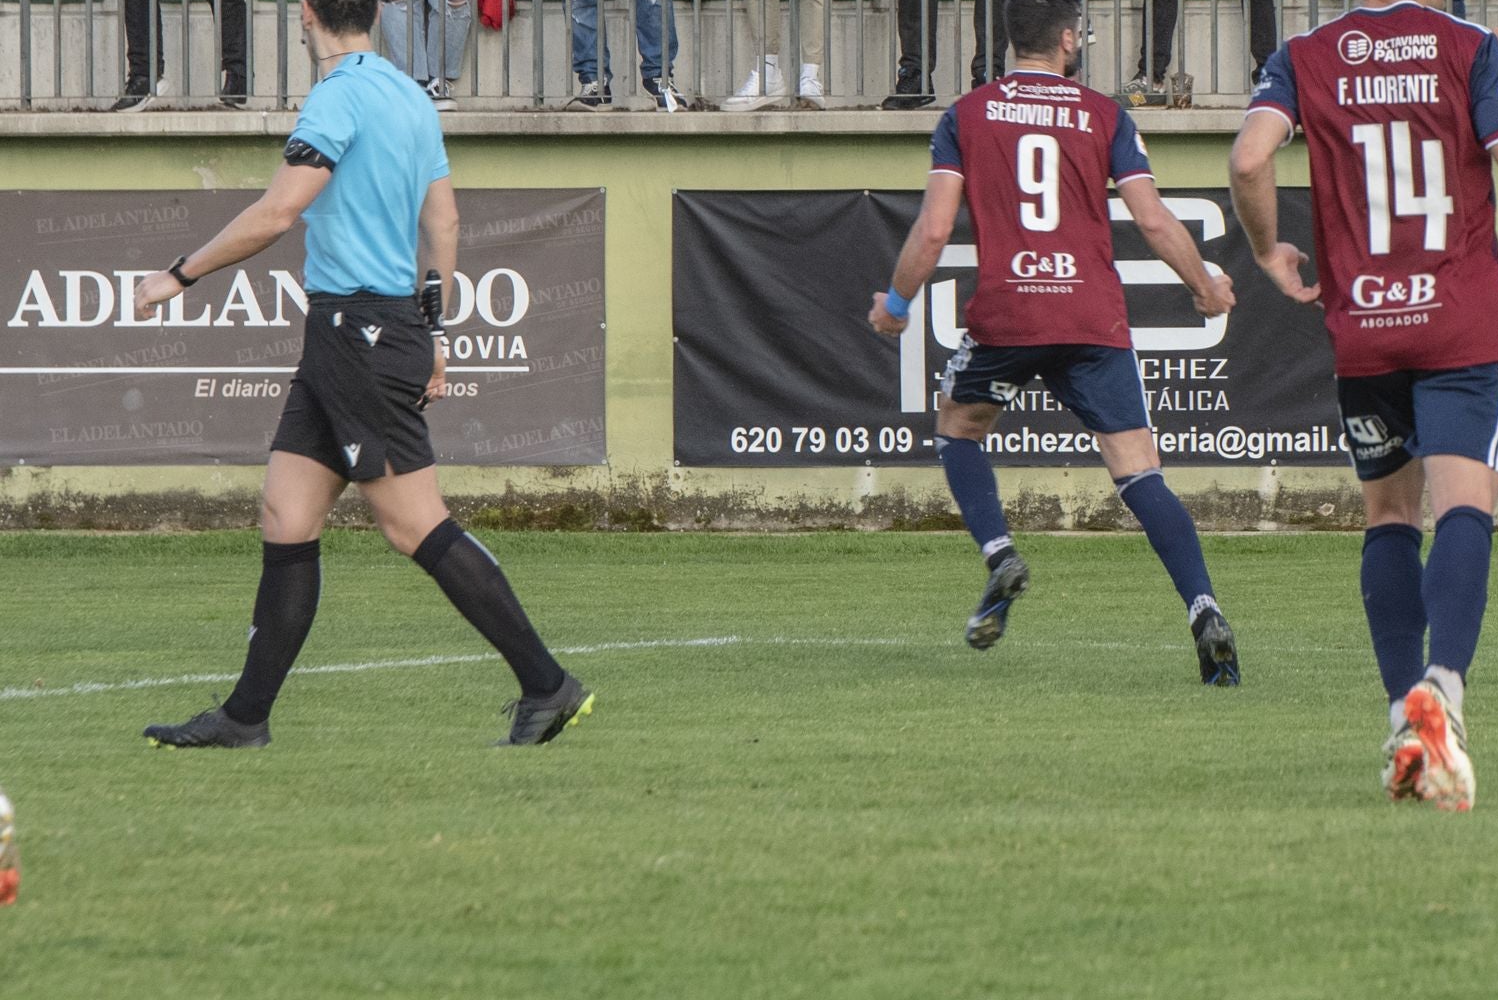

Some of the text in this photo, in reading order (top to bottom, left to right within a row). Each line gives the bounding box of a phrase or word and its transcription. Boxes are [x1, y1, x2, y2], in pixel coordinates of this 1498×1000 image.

[1373, 45, 1437, 63] PALOMO
[1375, 34, 1437, 50] OCTAVIANO
[1337, 74, 1439, 106] F. LLORENTE
[986, 100, 1093, 133] SEGOVIA H. V.
[1016, 133, 1061, 233] 9
[1351, 120, 1454, 255] 14
[1010, 250, 1078, 279] G&B
[1016, 285, 1074, 294] ABOGADOS
[1351, 273, 1437, 309] G&B
[1360, 313, 1429, 329] ABOGADOS
[1140, 358, 1229, 380] CHEZ
[194, 378, 281, 398] El diario
[731, 426, 782, 453] 620
[791, 426, 826, 453] 79
[835, 426, 870, 453] 03
[878, 426, 913, 453] 09
